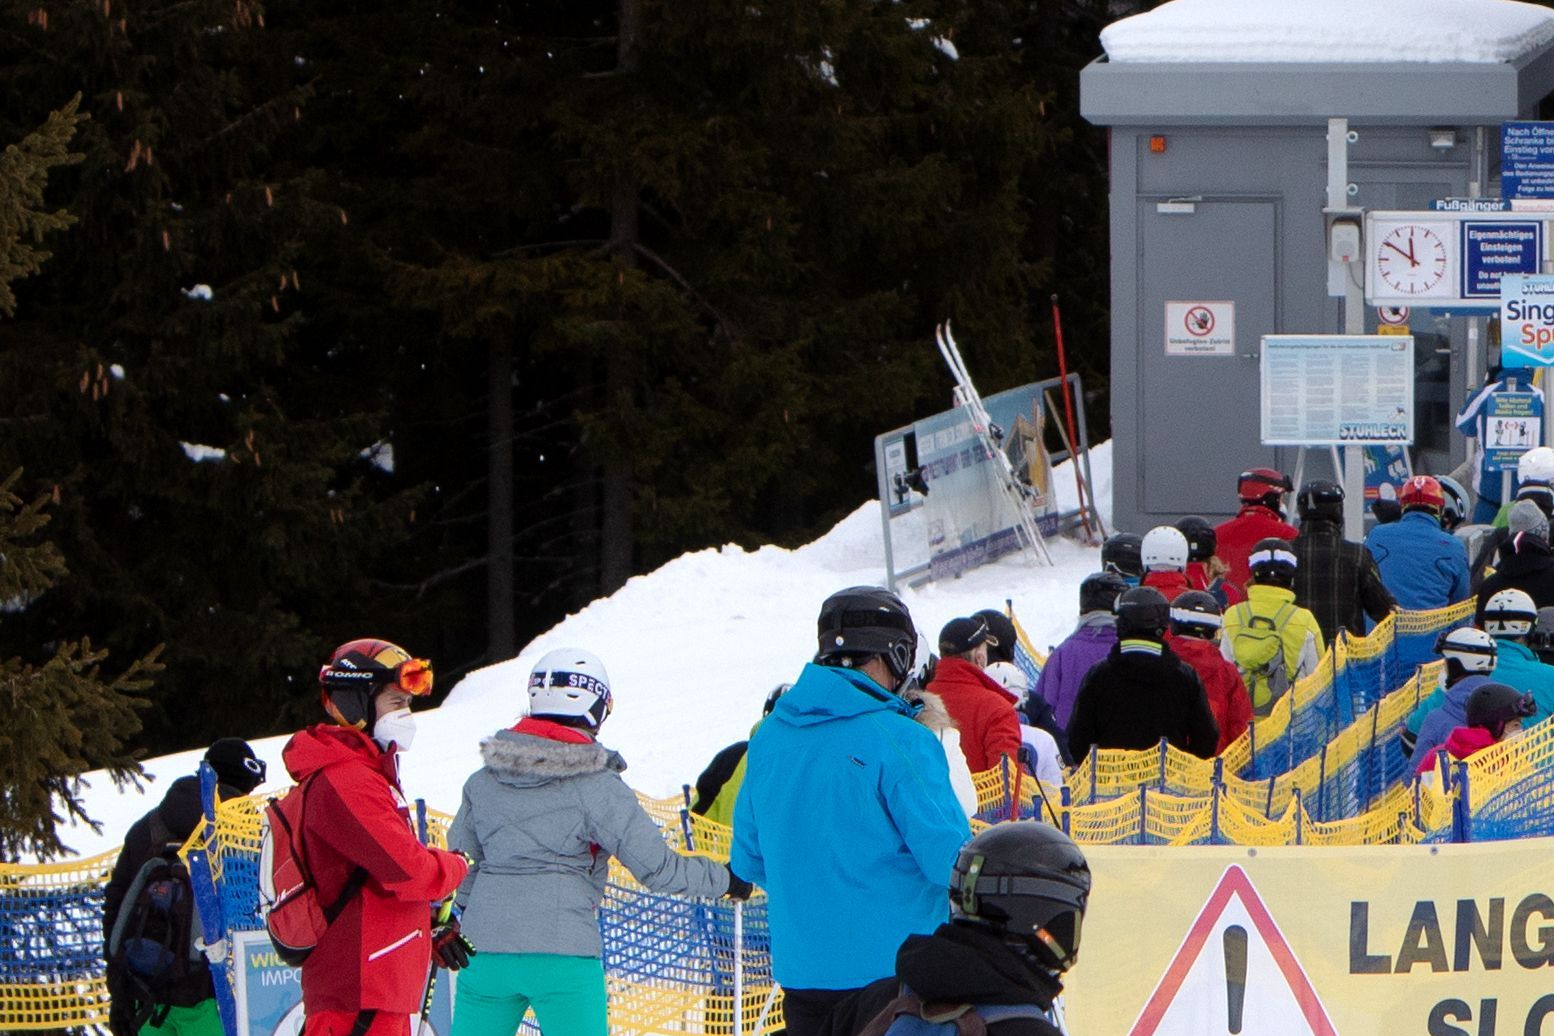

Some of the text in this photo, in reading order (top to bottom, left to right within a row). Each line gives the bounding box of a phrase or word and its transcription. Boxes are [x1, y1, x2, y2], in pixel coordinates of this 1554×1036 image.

[1508, 128, 1529, 136] Nach
[1504, 136, 1544, 144] Schranke
[1504, 146, 1538, 154] Einstieg
[1436, 200, 1505, 211] Fußgänger
[1470, 230, 1534, 240] Eigenmächtiges
[1480, 243, 1522, 252] Einsteigen
[1482, 256, 1520, 264] verboten!
[1478, 271, 1488, 279] Do
[1339, 422, 1406, 440] STUHLECK
[569, 674, 608, 700] SPECT
[250, 952, 287, 968] WIC
[262, 967, 302, 987] IMPO
